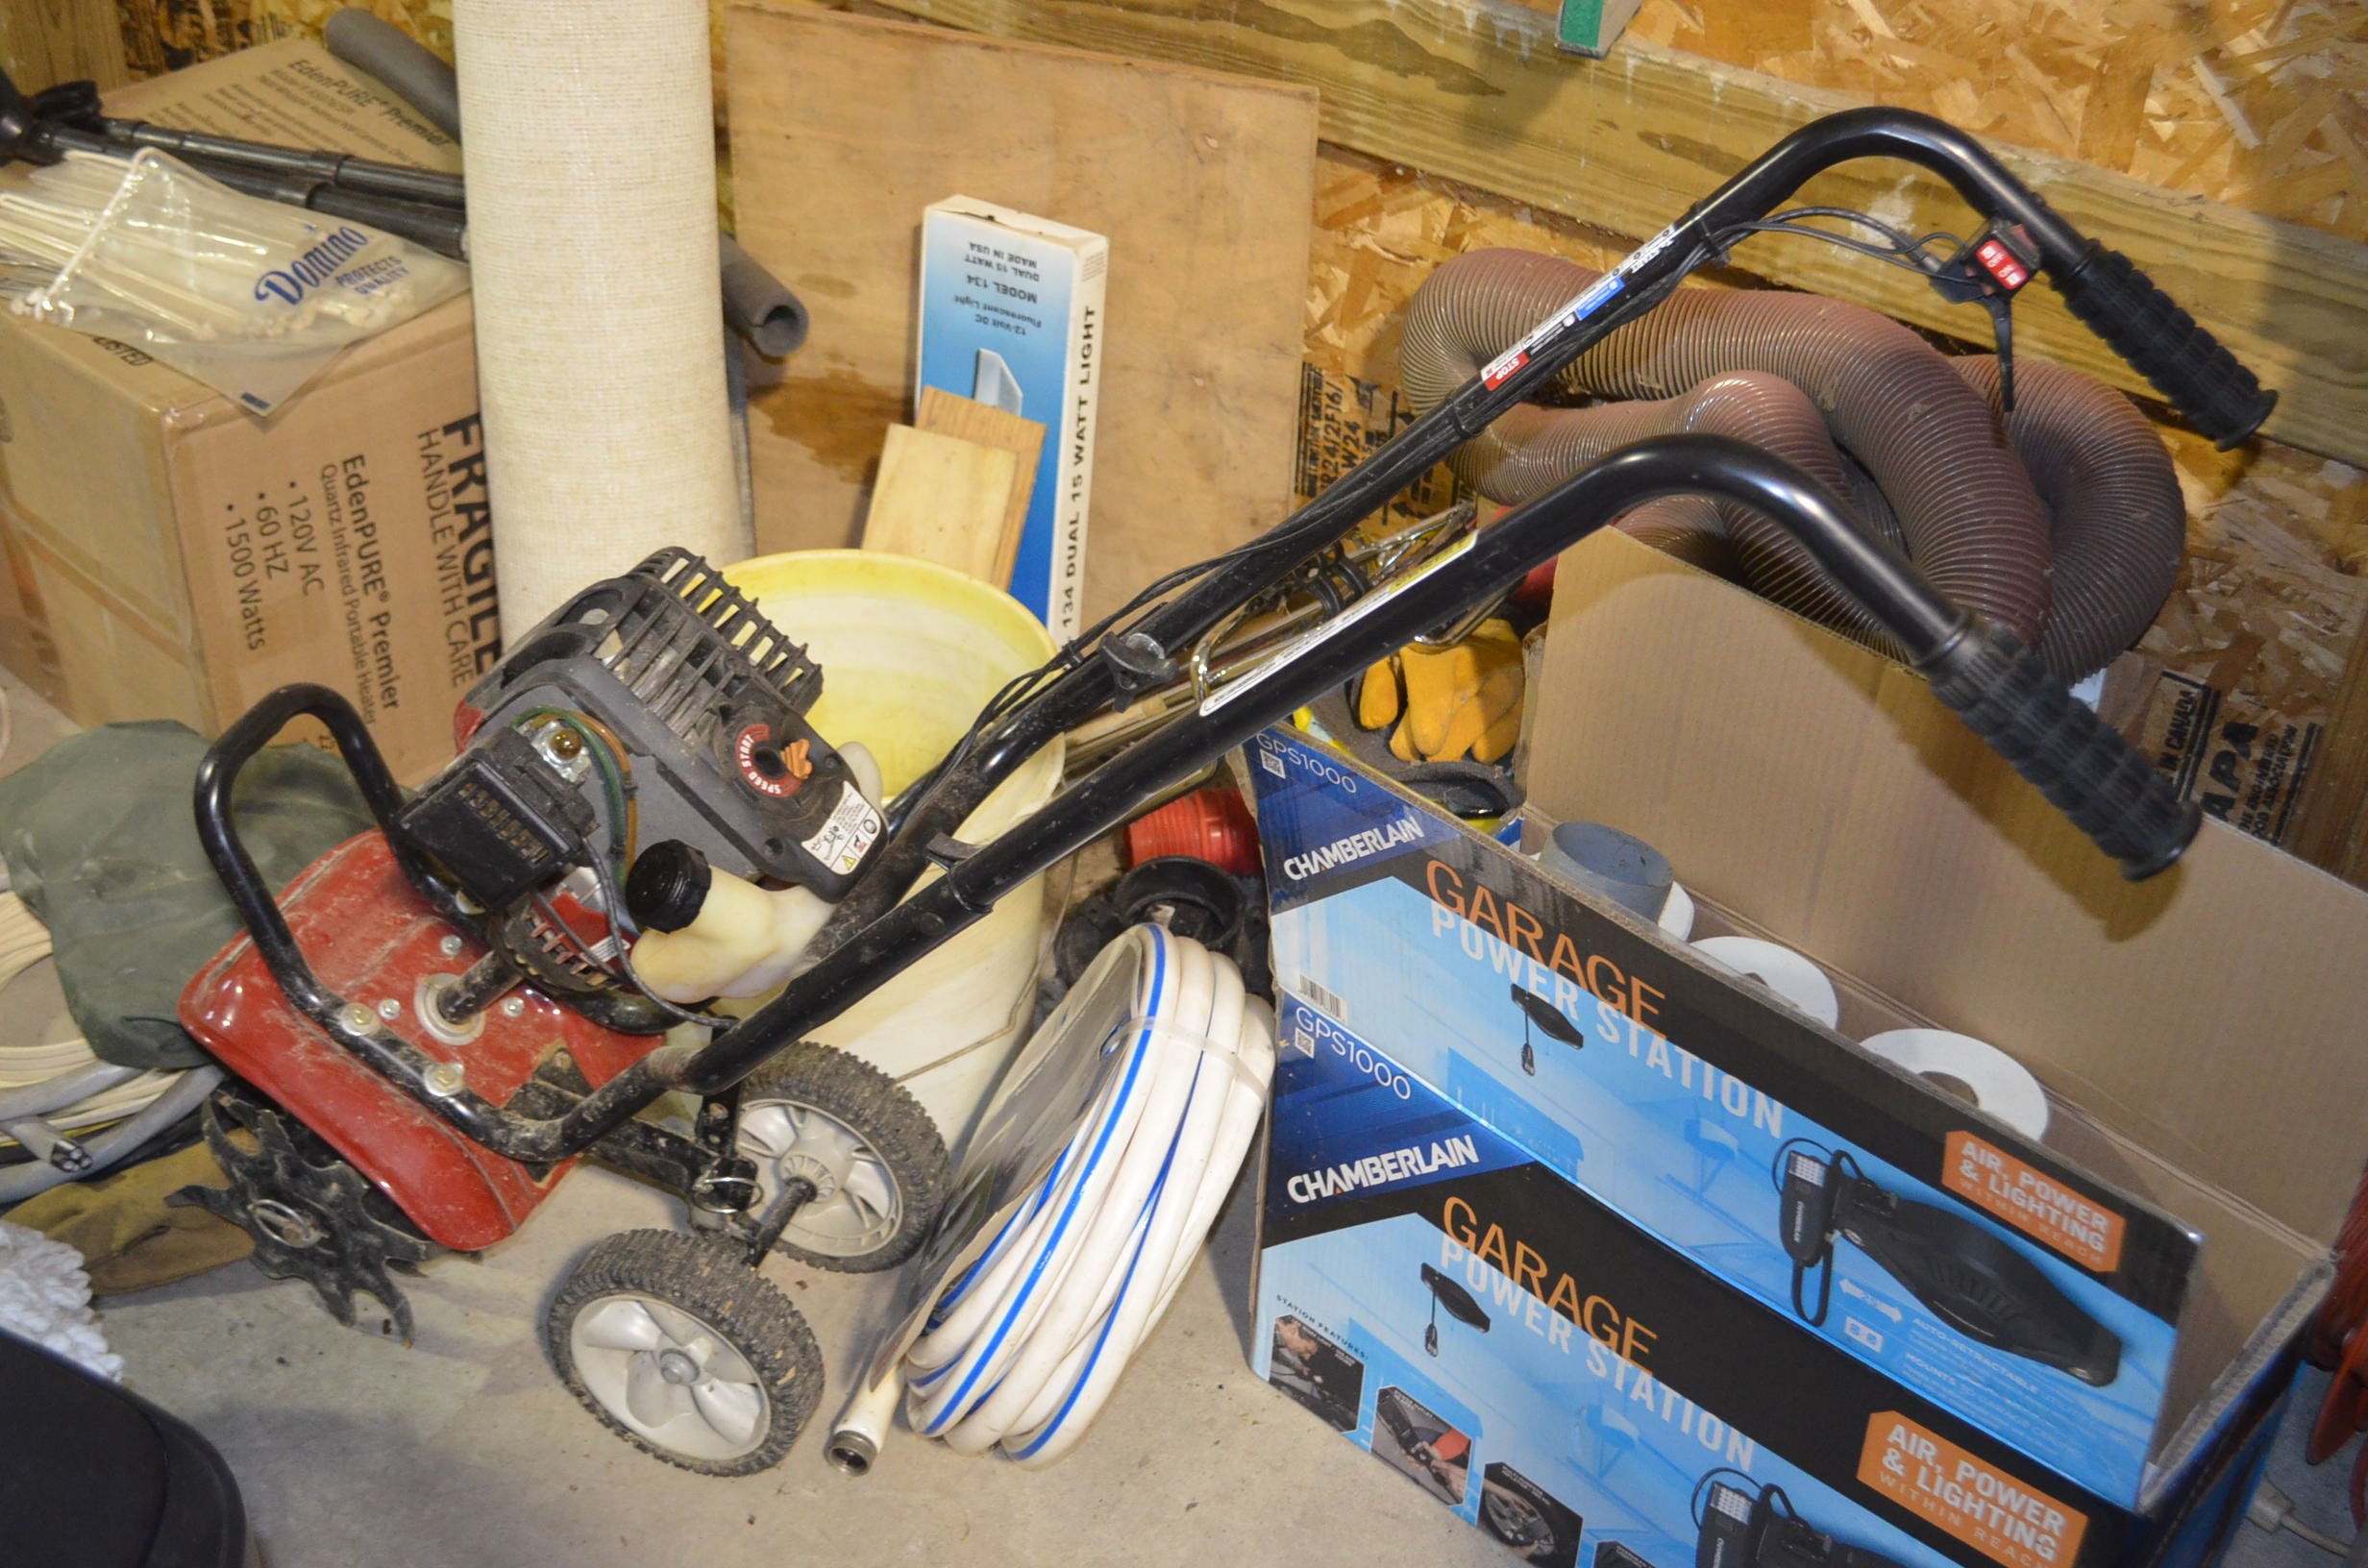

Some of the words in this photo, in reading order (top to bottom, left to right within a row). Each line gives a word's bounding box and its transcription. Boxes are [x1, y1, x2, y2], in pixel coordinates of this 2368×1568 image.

[963, 253, 994, 269] WATT
[967, 274, 989, 289] 134
[969, 241, 991, 257] USA
[993, 248, 1004, 259] IN
[995, 262, 1009, 274] 15
[1007, 252, 1038, 269] MADE
[1010, 266, 1040, 282] DUAL
[993, 281, 1038, 304] MODEL
[1079, 305, 1096, 386] LIGHT
[1494, 356, 1520, 380] STOP
[1073, 395, 1089, 467] WATT
[320, 463, 343, 529] Quartz
[417, 429, 454, 545] HANDLE
[1071, 474, 1083, 503] 15
[225, 517, 256, 577] 1500
[256, 504, 281, 537] 60
[288, 495, 319, 555] 120V
[443, 411, 503, 676] FRAGILE
[1065, 511, 1080, 577] DUAL
[261, 538, 289, 580] HZ
[300, 562, 325, 597] AC
[331, 527, 357, 597] Infrared
[436, 545, 467, 618] WITH
[237, 579, 266, 651] Watts
[342, 597, 367, 671] Portable
[1062, 585, 1074, 627] 134
[369, 610, 403, 710] Premier
[445, 621, 474, 688] CARE
[357, 671, 378, 726] Heater
[2164, 689, 2196, 751] CANADA
[739, 733, 755, 769] START
[1255, 732, 1358, 795] GPS1000
[2200, 720, 2259, 823] APA
[1283, 816, 1425, 882] CHAMBERLAIN
[1425, 859, 1667, 1039] GARAGE
[1430, 899, 1579, 1023] POWER
[1596, 999, 1784, 1139] STATION
[1295, 1005, 1412, 1101] GPS1000
[1287, 1134, 1479, 1205] CHAMBERLAIN
[1958, 1159, 1981, 1184] &
[1989, 1172, 2107, 1254] LIGHTING
[2019, 1170, 2109, 1235] POWER
[1275, 1293, 1318, 1325] STATION
[1443, 1195, 1659, 1375] GARAGE
[1440, 1232, 1572, 1355] POWER
[1585, 1345, 1757, 1473] STATION
[1879, 1471, 1962, 1529] WITHIN
[1881, 1448, 1906, 1477] &
[1915, 1467, 2060, 1562] LIGHTING
[1887, 1423, 1942, 1476] AIR,
[1955, 1459, 2066, 1538] POWER
